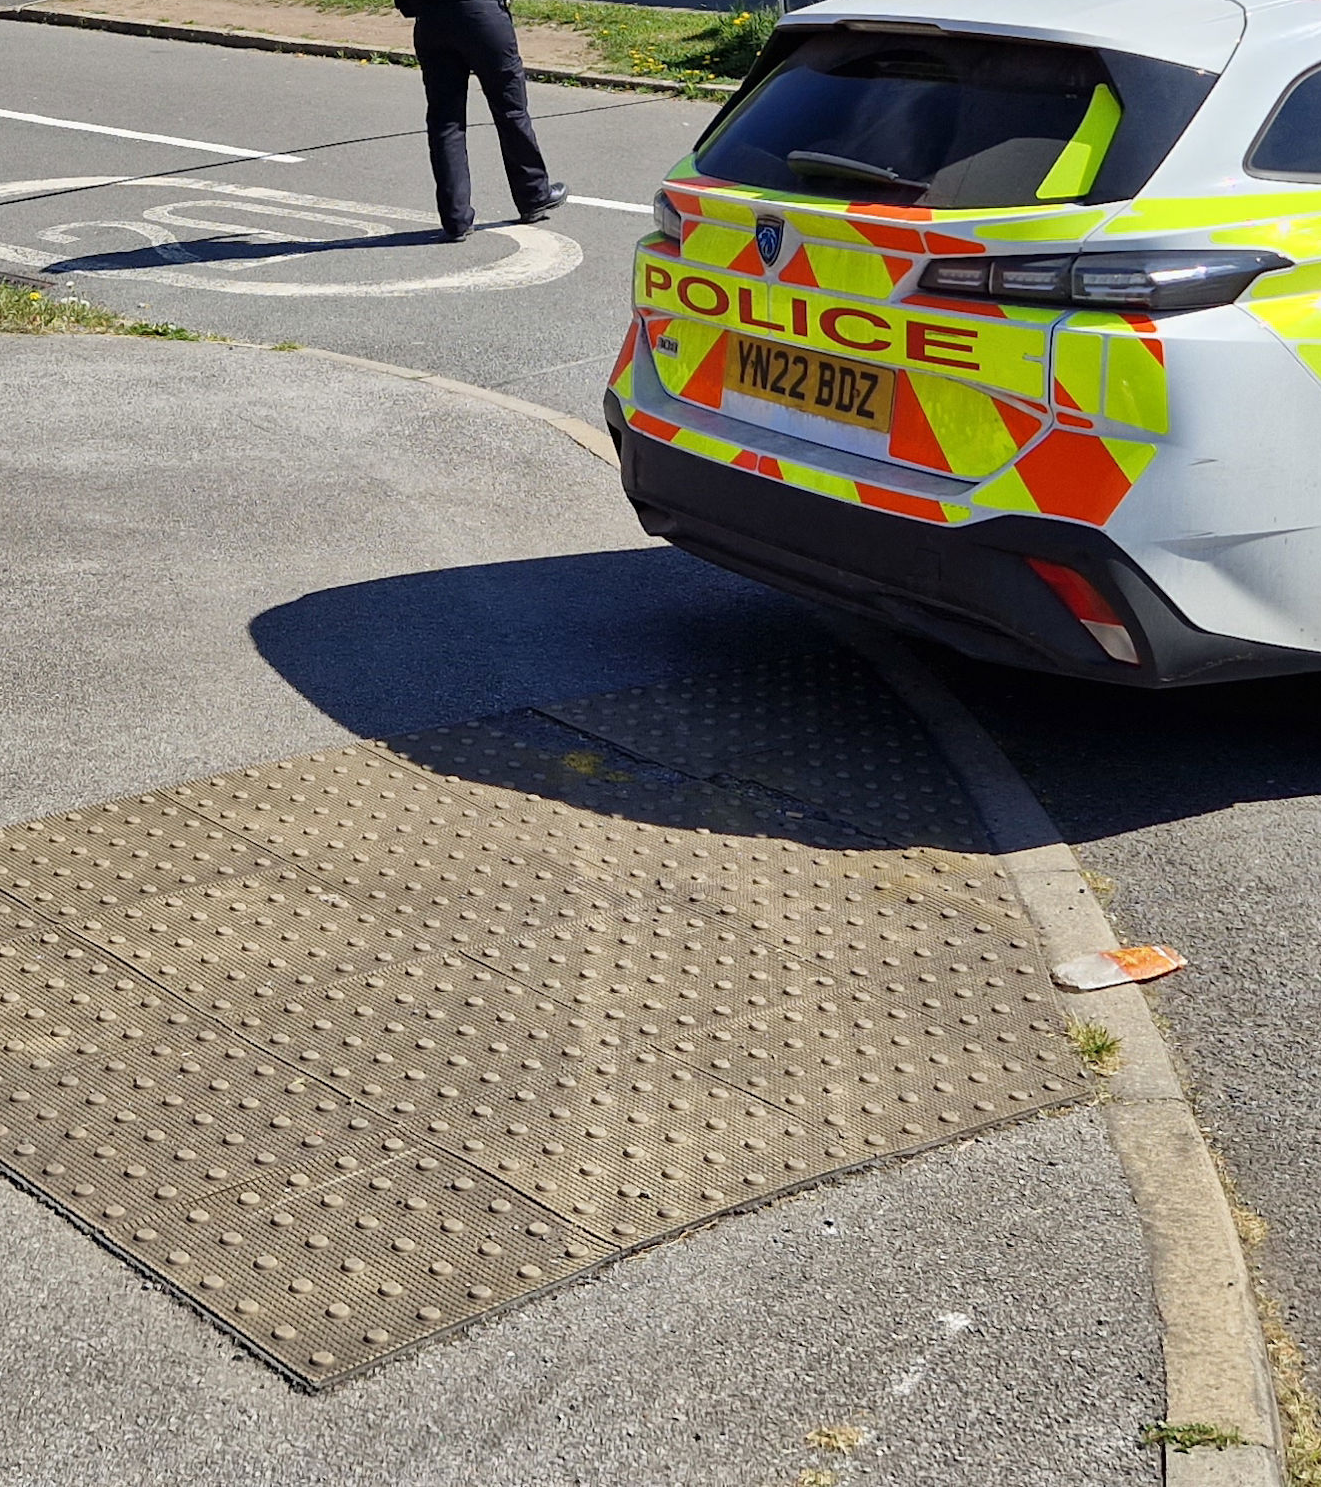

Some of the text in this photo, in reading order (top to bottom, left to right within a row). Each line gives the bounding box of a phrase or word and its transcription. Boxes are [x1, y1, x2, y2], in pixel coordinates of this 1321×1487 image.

[645, 263, 980, 370] POLICE
[738, 340, 879, 420] YN22 BDZ
